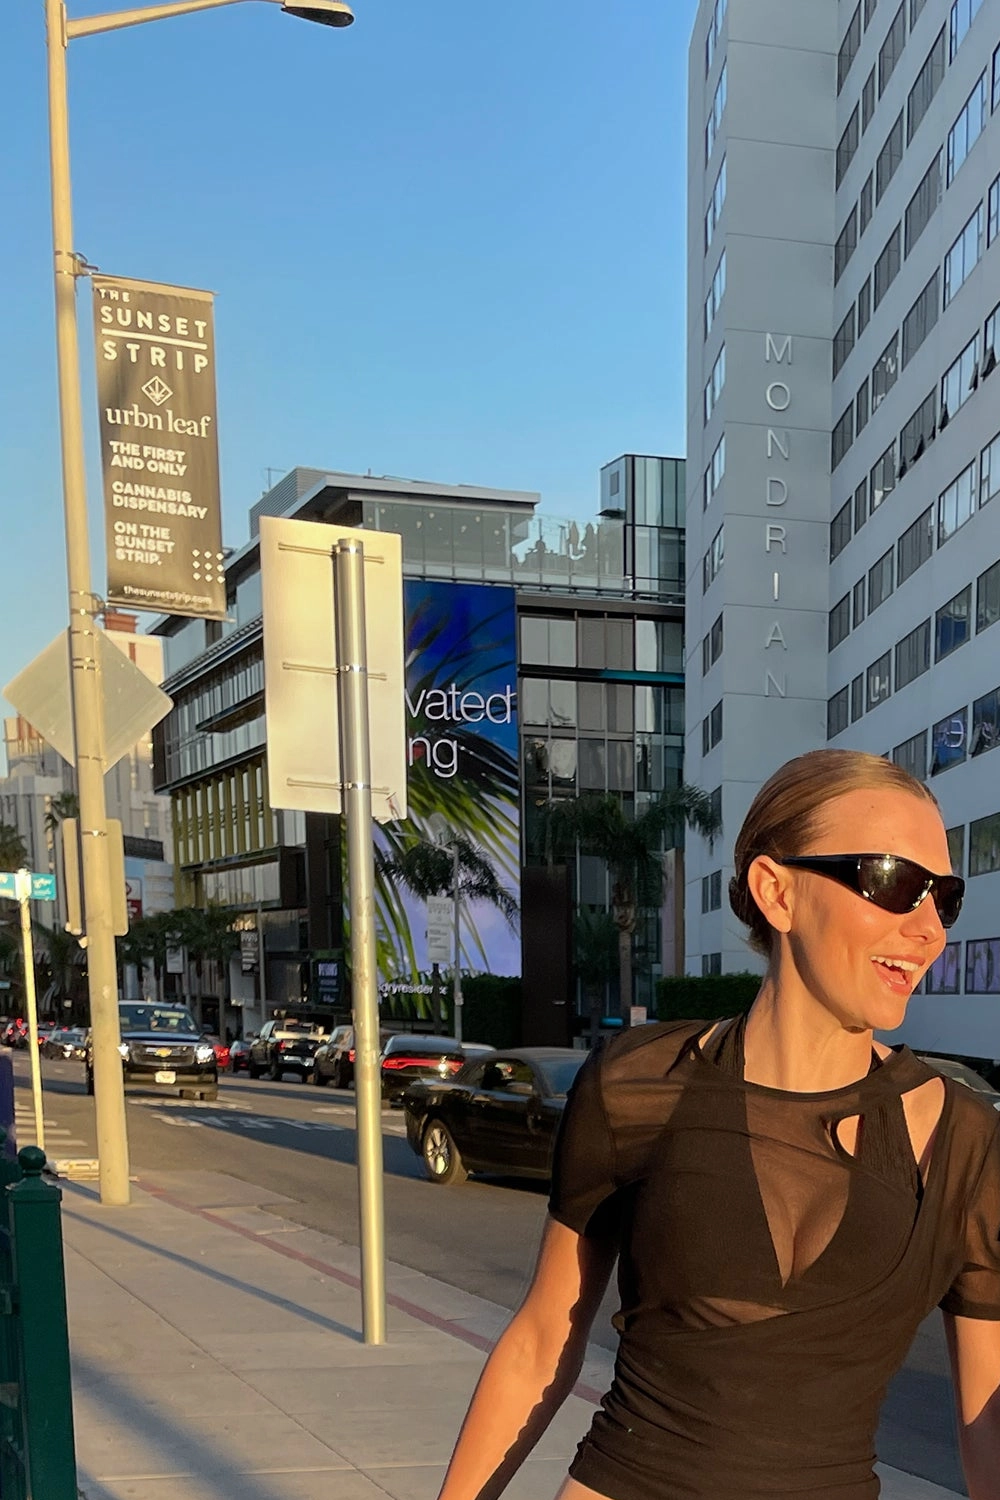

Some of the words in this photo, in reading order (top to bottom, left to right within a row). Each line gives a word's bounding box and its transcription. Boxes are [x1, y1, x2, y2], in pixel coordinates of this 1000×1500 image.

[100, 288, 130, 302] THE
[100, 305, 207, 339] SUNSET
[103, 341, 208, 374] STRIP
[105, 403, 164, 431] urbn
[166, 409, 212, 438] leaf
[109, 440, 140, 456] THE
[143, 445, 186, 463] FIRST
[111, 454, 145, 470] AND
[147, 459, 187, 477] ONLY
[112, 481, 192, 504] CANNABIS
[113, 494, 208, 519] DISPENSARY
[765, 333, 793, 698] MONDRIAN
[114, 521, 138, 536] ON
[140, 524, 170, 540] THE
[115, 534, 175, 554] SUNSET
[116, 548, 162, 566] STRIP.
[405, 683, 512, 724] vated
